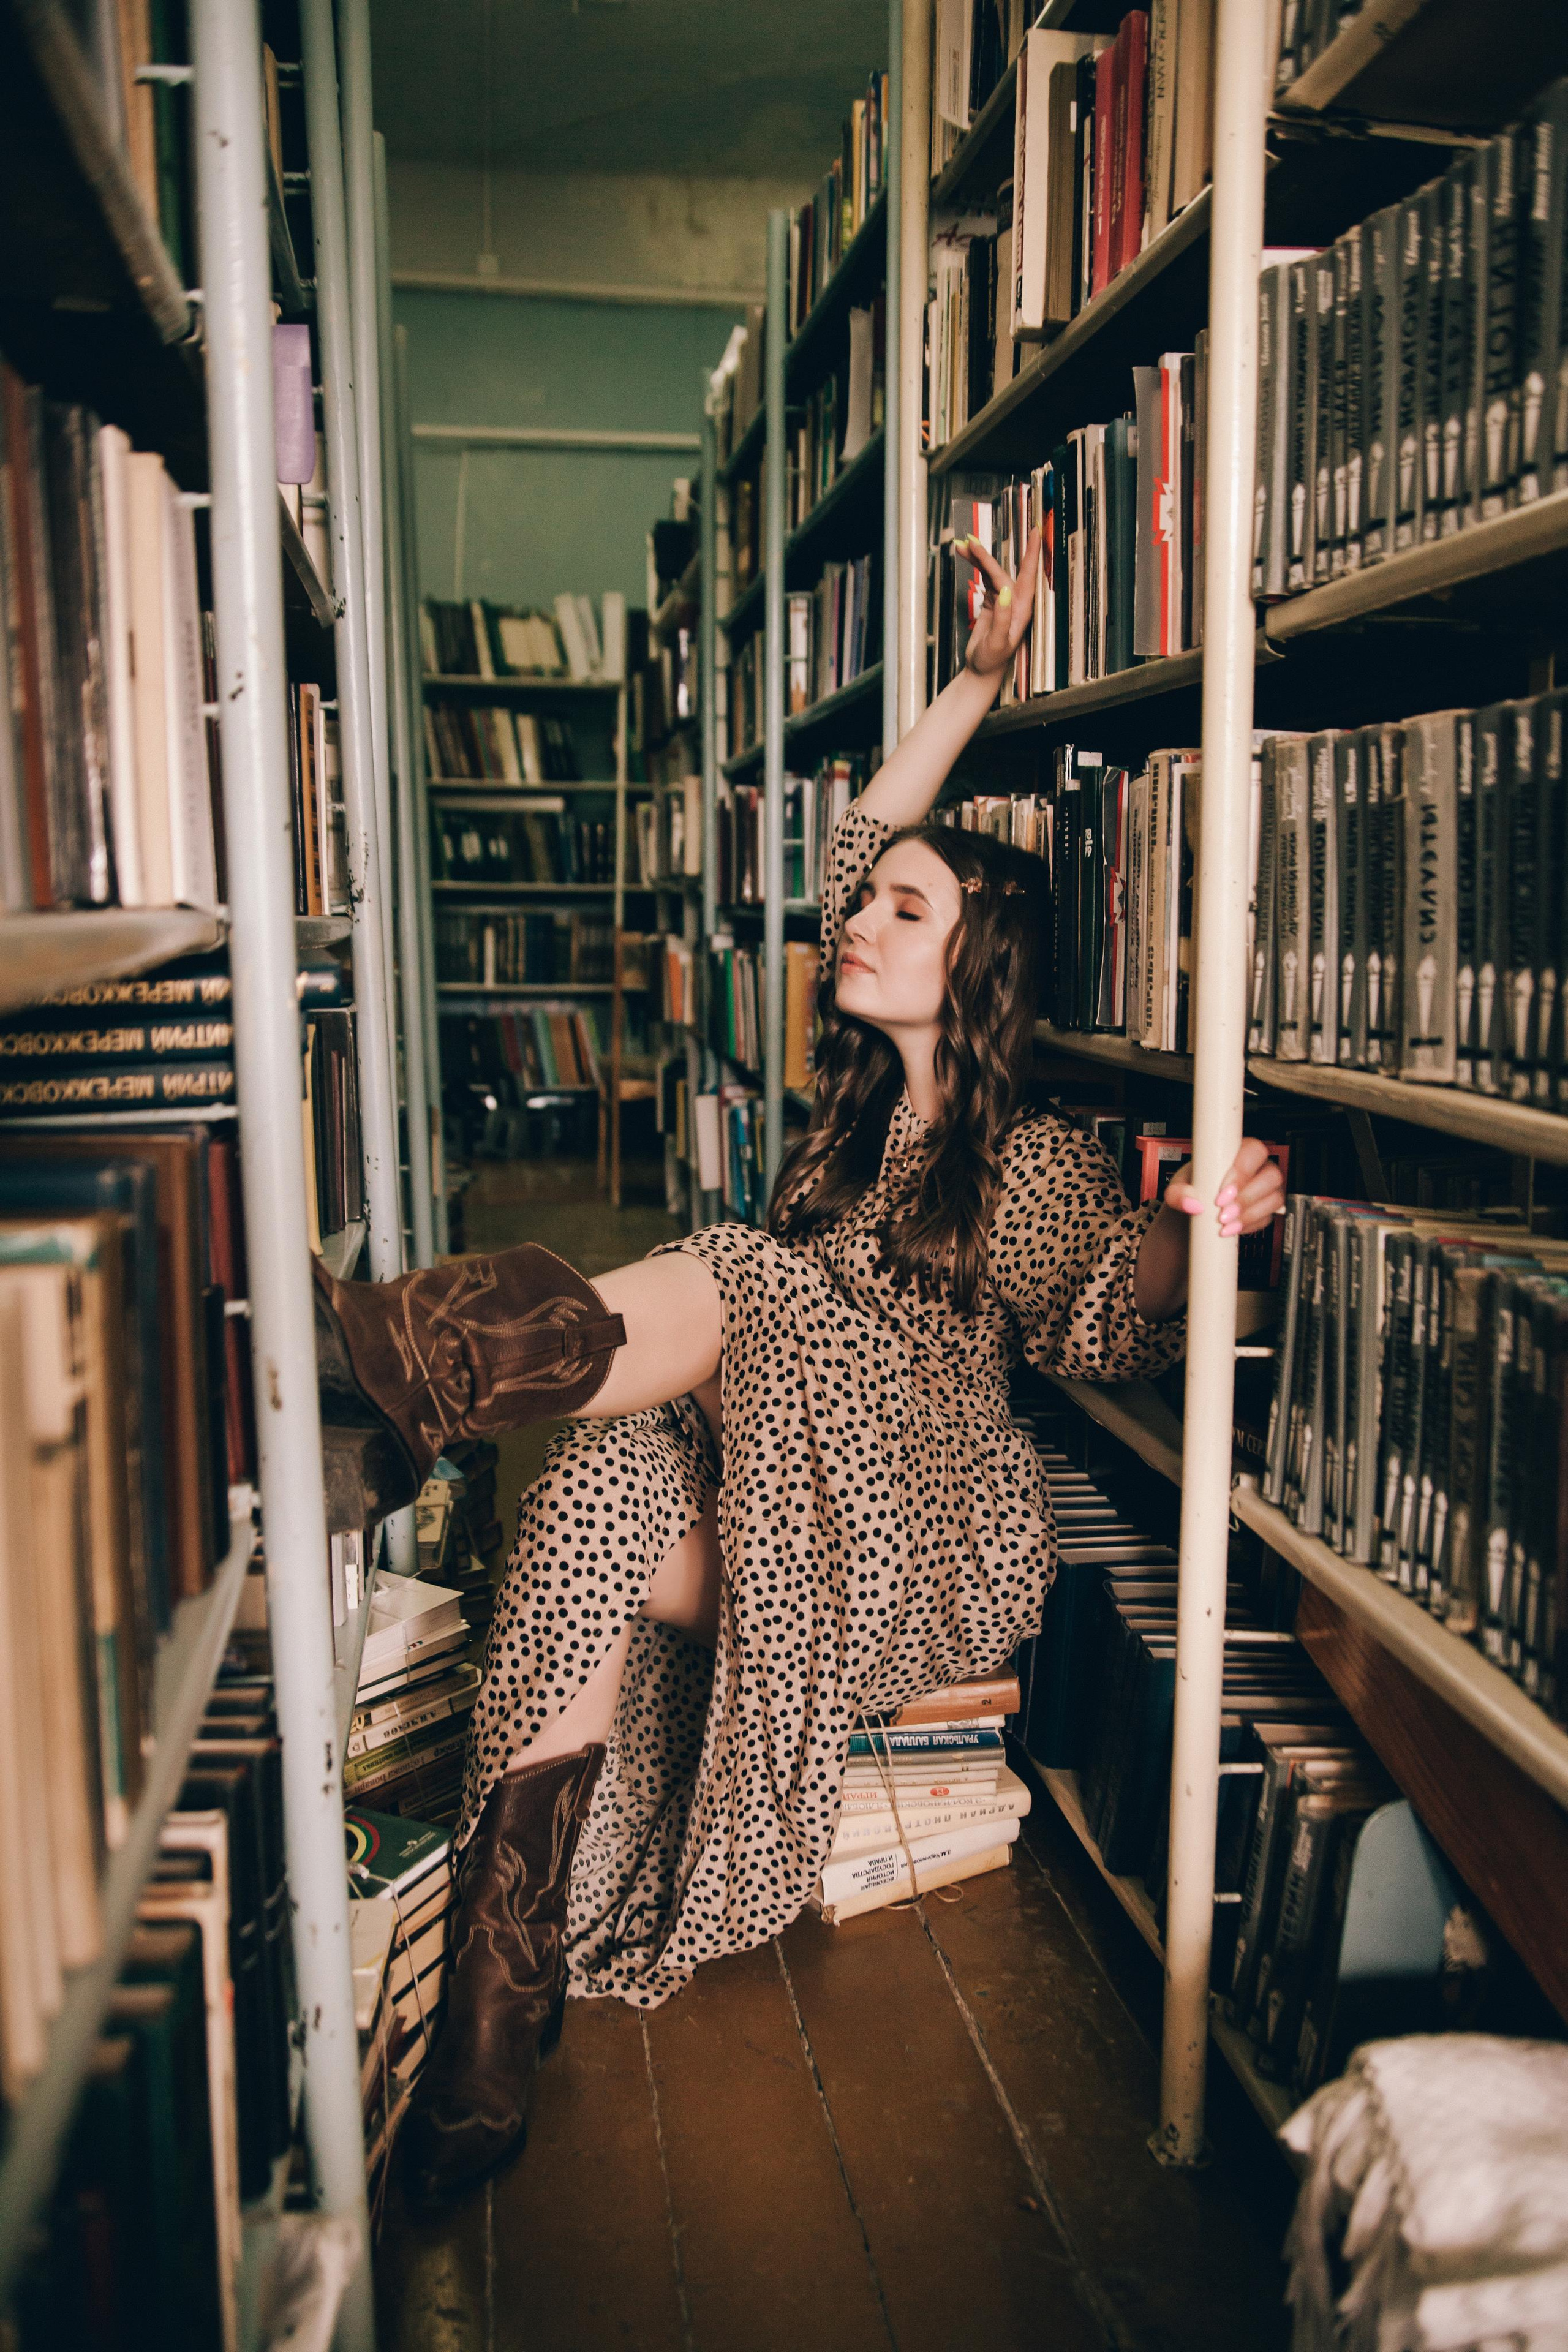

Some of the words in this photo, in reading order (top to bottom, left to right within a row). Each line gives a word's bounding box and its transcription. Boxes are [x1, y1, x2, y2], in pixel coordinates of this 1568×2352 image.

[1419, 804, 1438, 945] СИЛУЭТЫ
[0, 1027, 145, 1057] МЕРЕЖКОВС
[0, 1074, 154, 1104] МЕРЕЖКОВСК
[889, 1735, 929, 1747] БАЛЛАДА
[933, 1734, 979, 1746] УРАЛЬСКАЯ
[897, 1798, 973, 1809] КОЛМАНОВСКИ
[960, 1804, 1014, 1818] АДРИАН
[842, 1814, 951, 1838] ПИОТРВСКИЙ
[867, 1856, 888, 1866] ПРАВА
[900, 1850, 951, 1869] З.М.Черниловий
[851, 1863, 894, 1879] ГОСУДАРСТВА
[865, 1870, 894, 1882] ИСТОРИЯ
[861, 1876, 894, 1891] ВСЕОБЩАЯ
